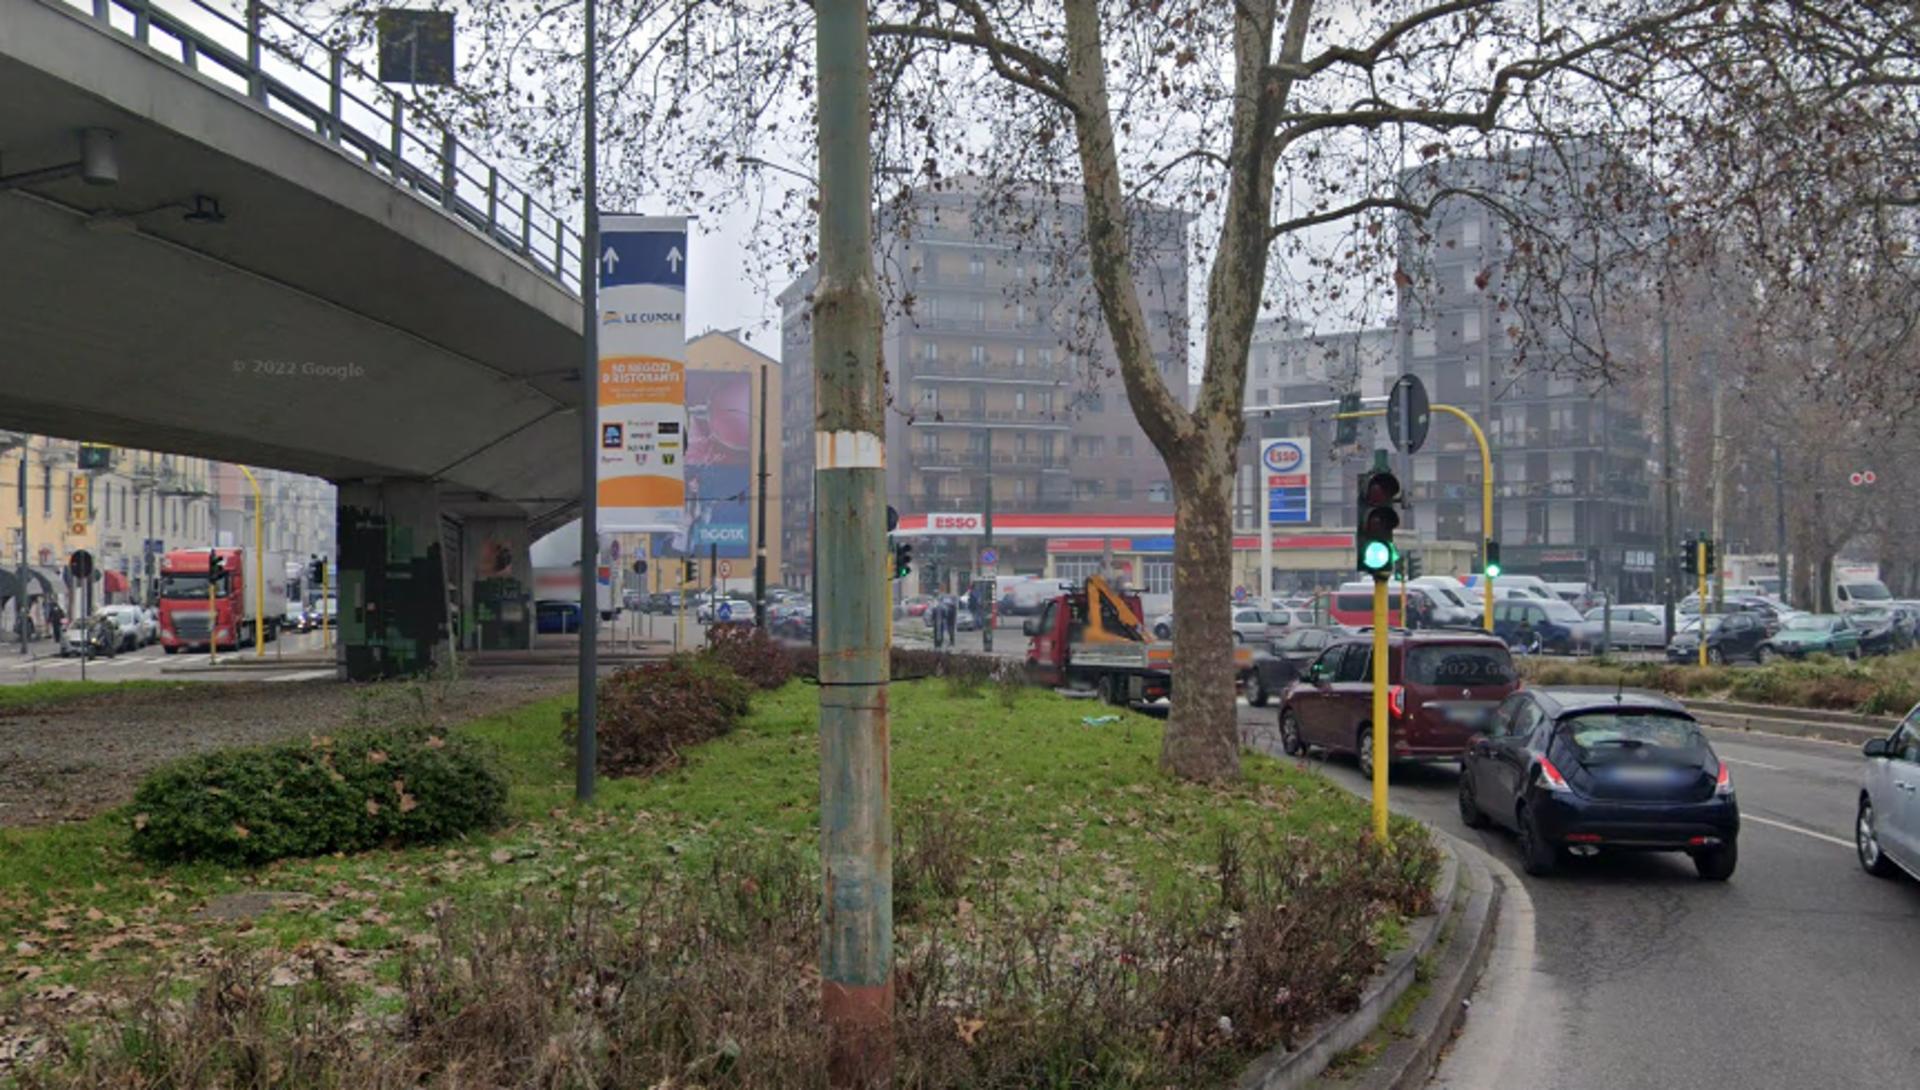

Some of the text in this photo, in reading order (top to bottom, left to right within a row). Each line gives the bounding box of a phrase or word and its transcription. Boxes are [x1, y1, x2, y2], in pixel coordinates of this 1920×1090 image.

[625, 312, 681, 323] LE CUPOLE
[73, 478, 87, 534] FOTO
